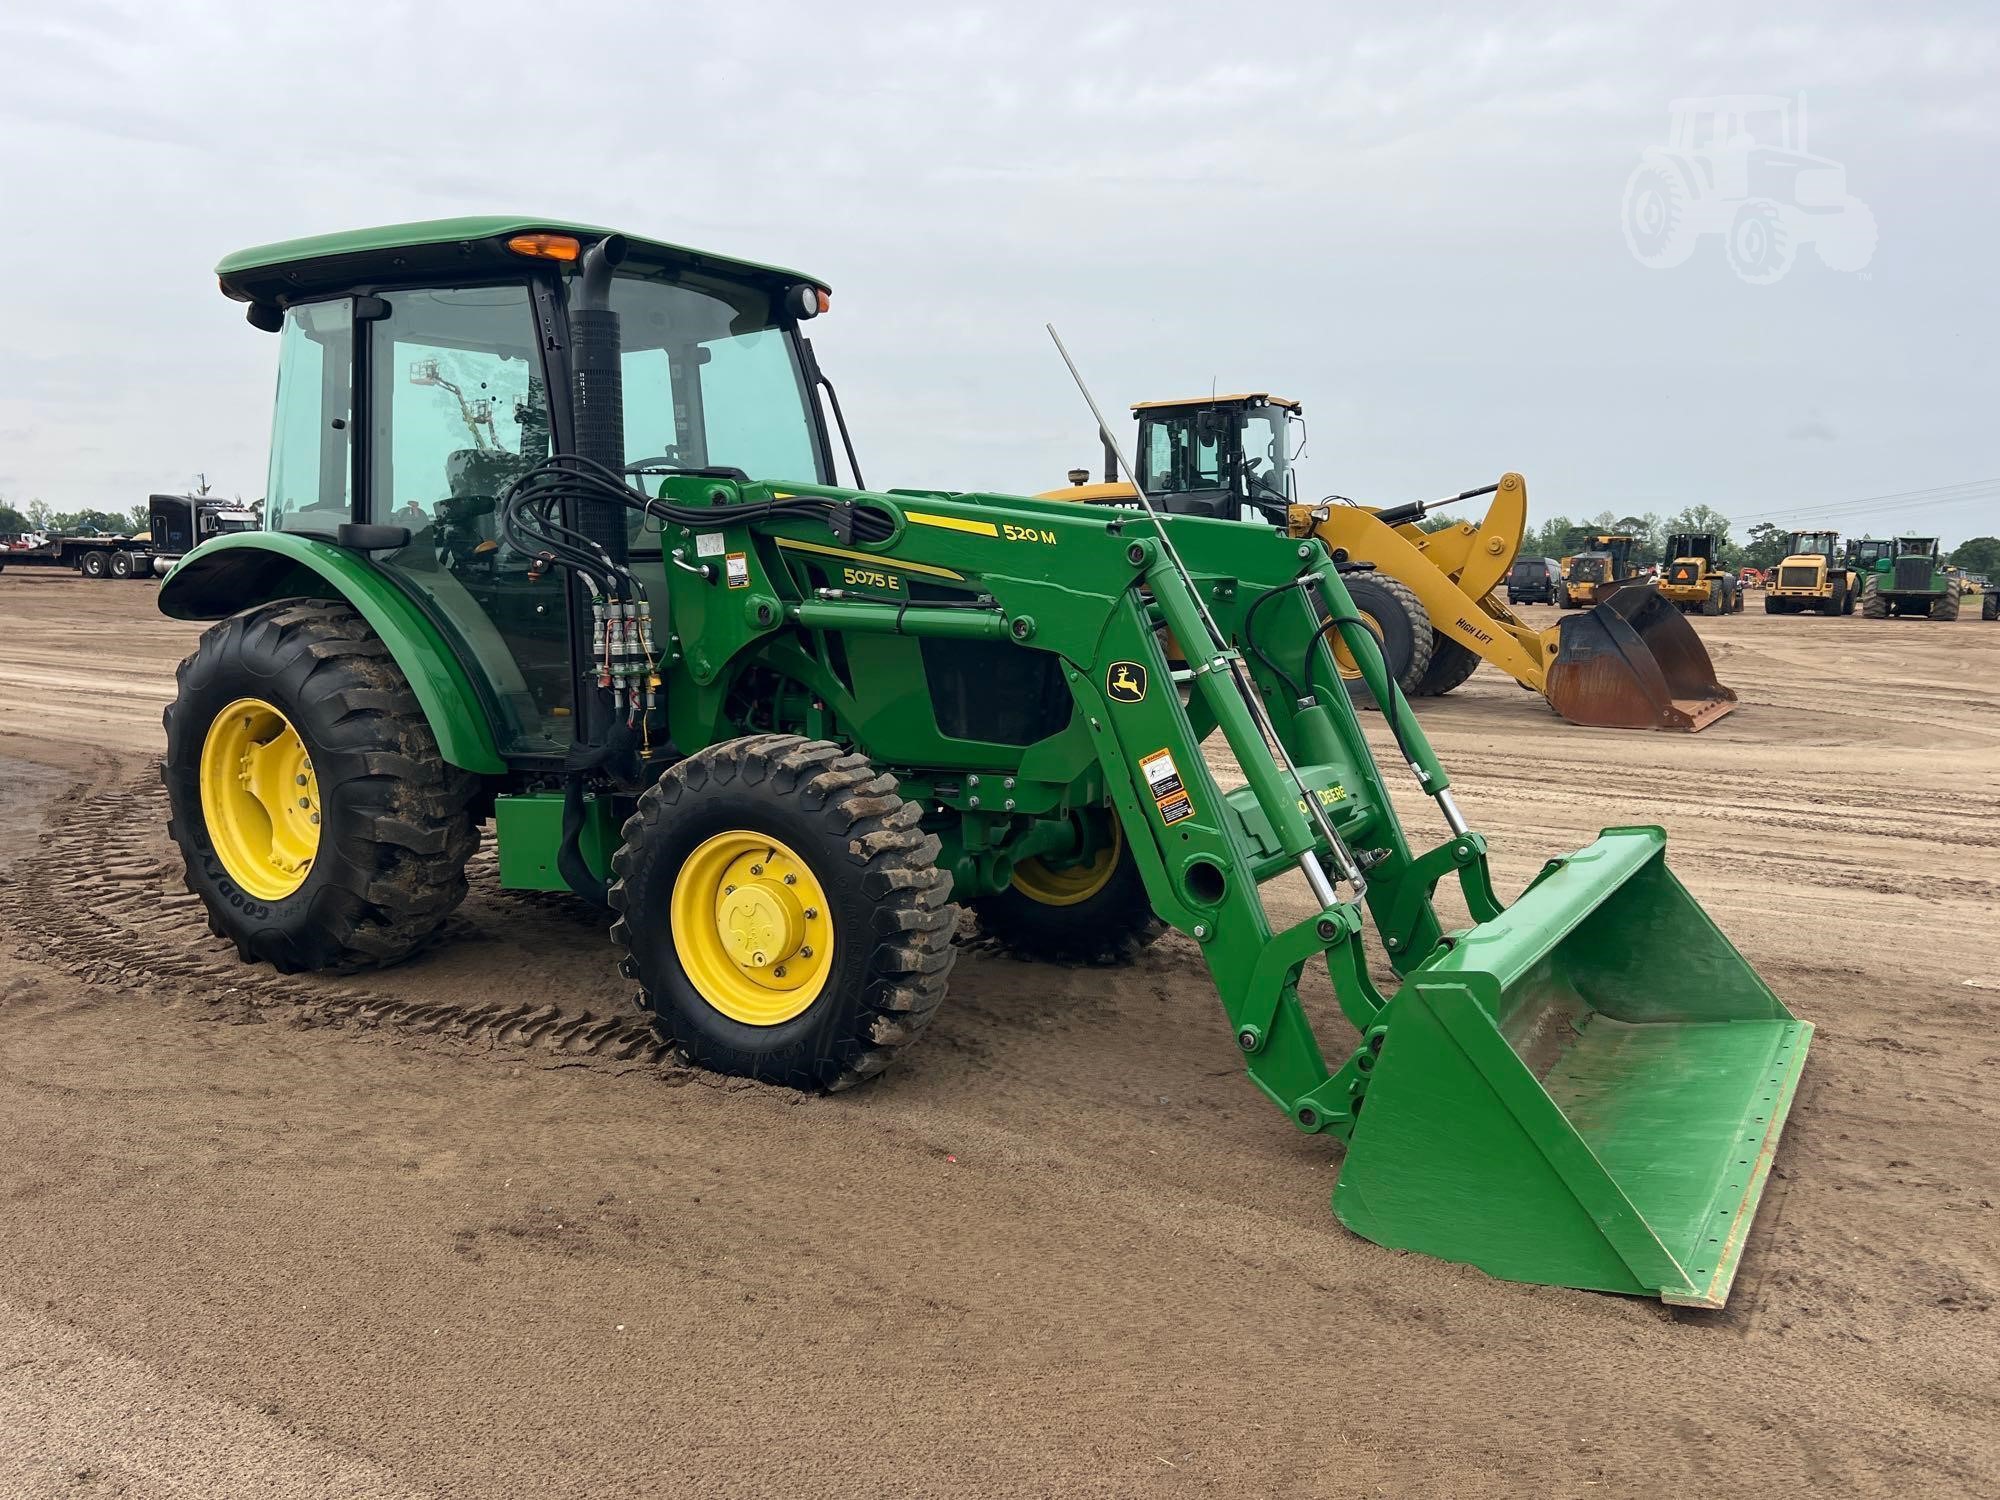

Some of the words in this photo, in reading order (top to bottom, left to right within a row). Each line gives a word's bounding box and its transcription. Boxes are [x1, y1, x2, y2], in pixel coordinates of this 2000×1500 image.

[1003, 524, 1038, 542] 520
[1040, 530, 1057, 545] M
[844, 568, 886, 587] 5075
[888, 575, 900, 590] E
[1455, 617, 1476, 635] HIGH
[1474, 629, 1494, 645] LIFT
[1316, 785, 1347, 806] DEERE
[190, 808, 269, 920] GOODYE
